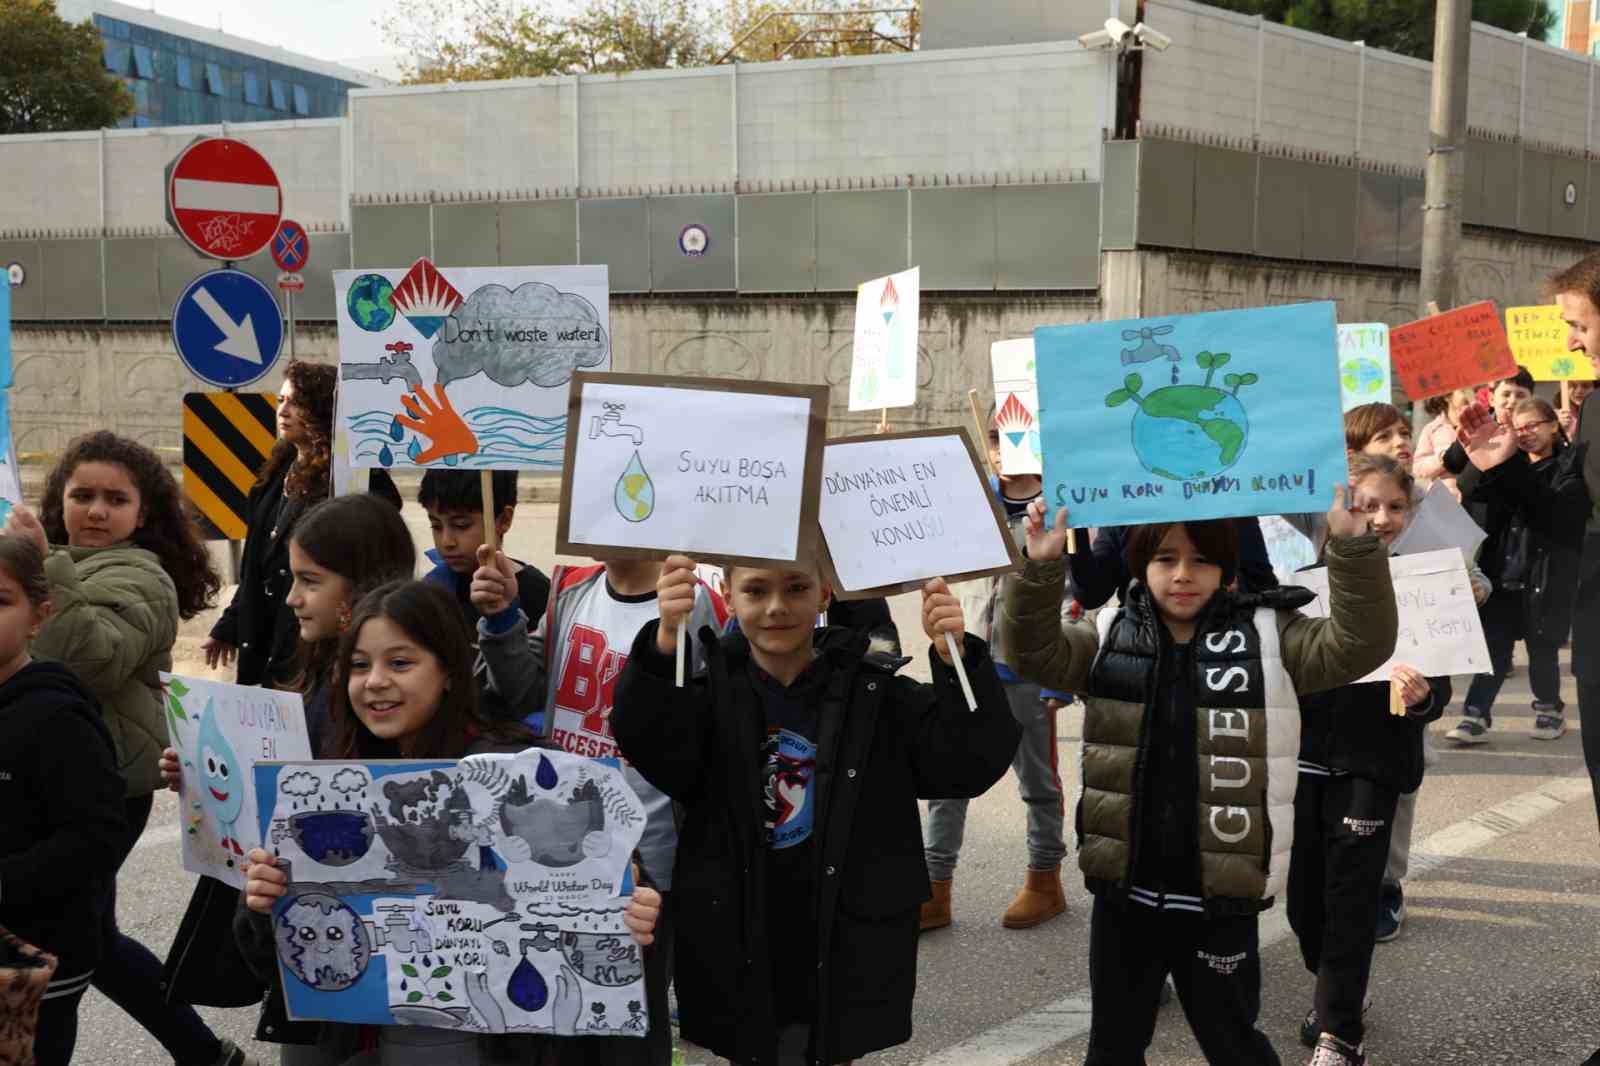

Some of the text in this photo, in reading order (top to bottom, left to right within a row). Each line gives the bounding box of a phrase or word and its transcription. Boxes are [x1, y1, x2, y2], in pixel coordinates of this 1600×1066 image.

[444, 314, 600, 344] Don't waste water!
[912, 461, 937, 481] EN
[694, 483, 769, 505] AKITMA
[870, 483, 932, 517] ÖNEMLİ
[1205, 629, 1252, 844] GUESS
[513, 878, 614, 896] World Water Day
[447, 918, 483, 933] KORU
